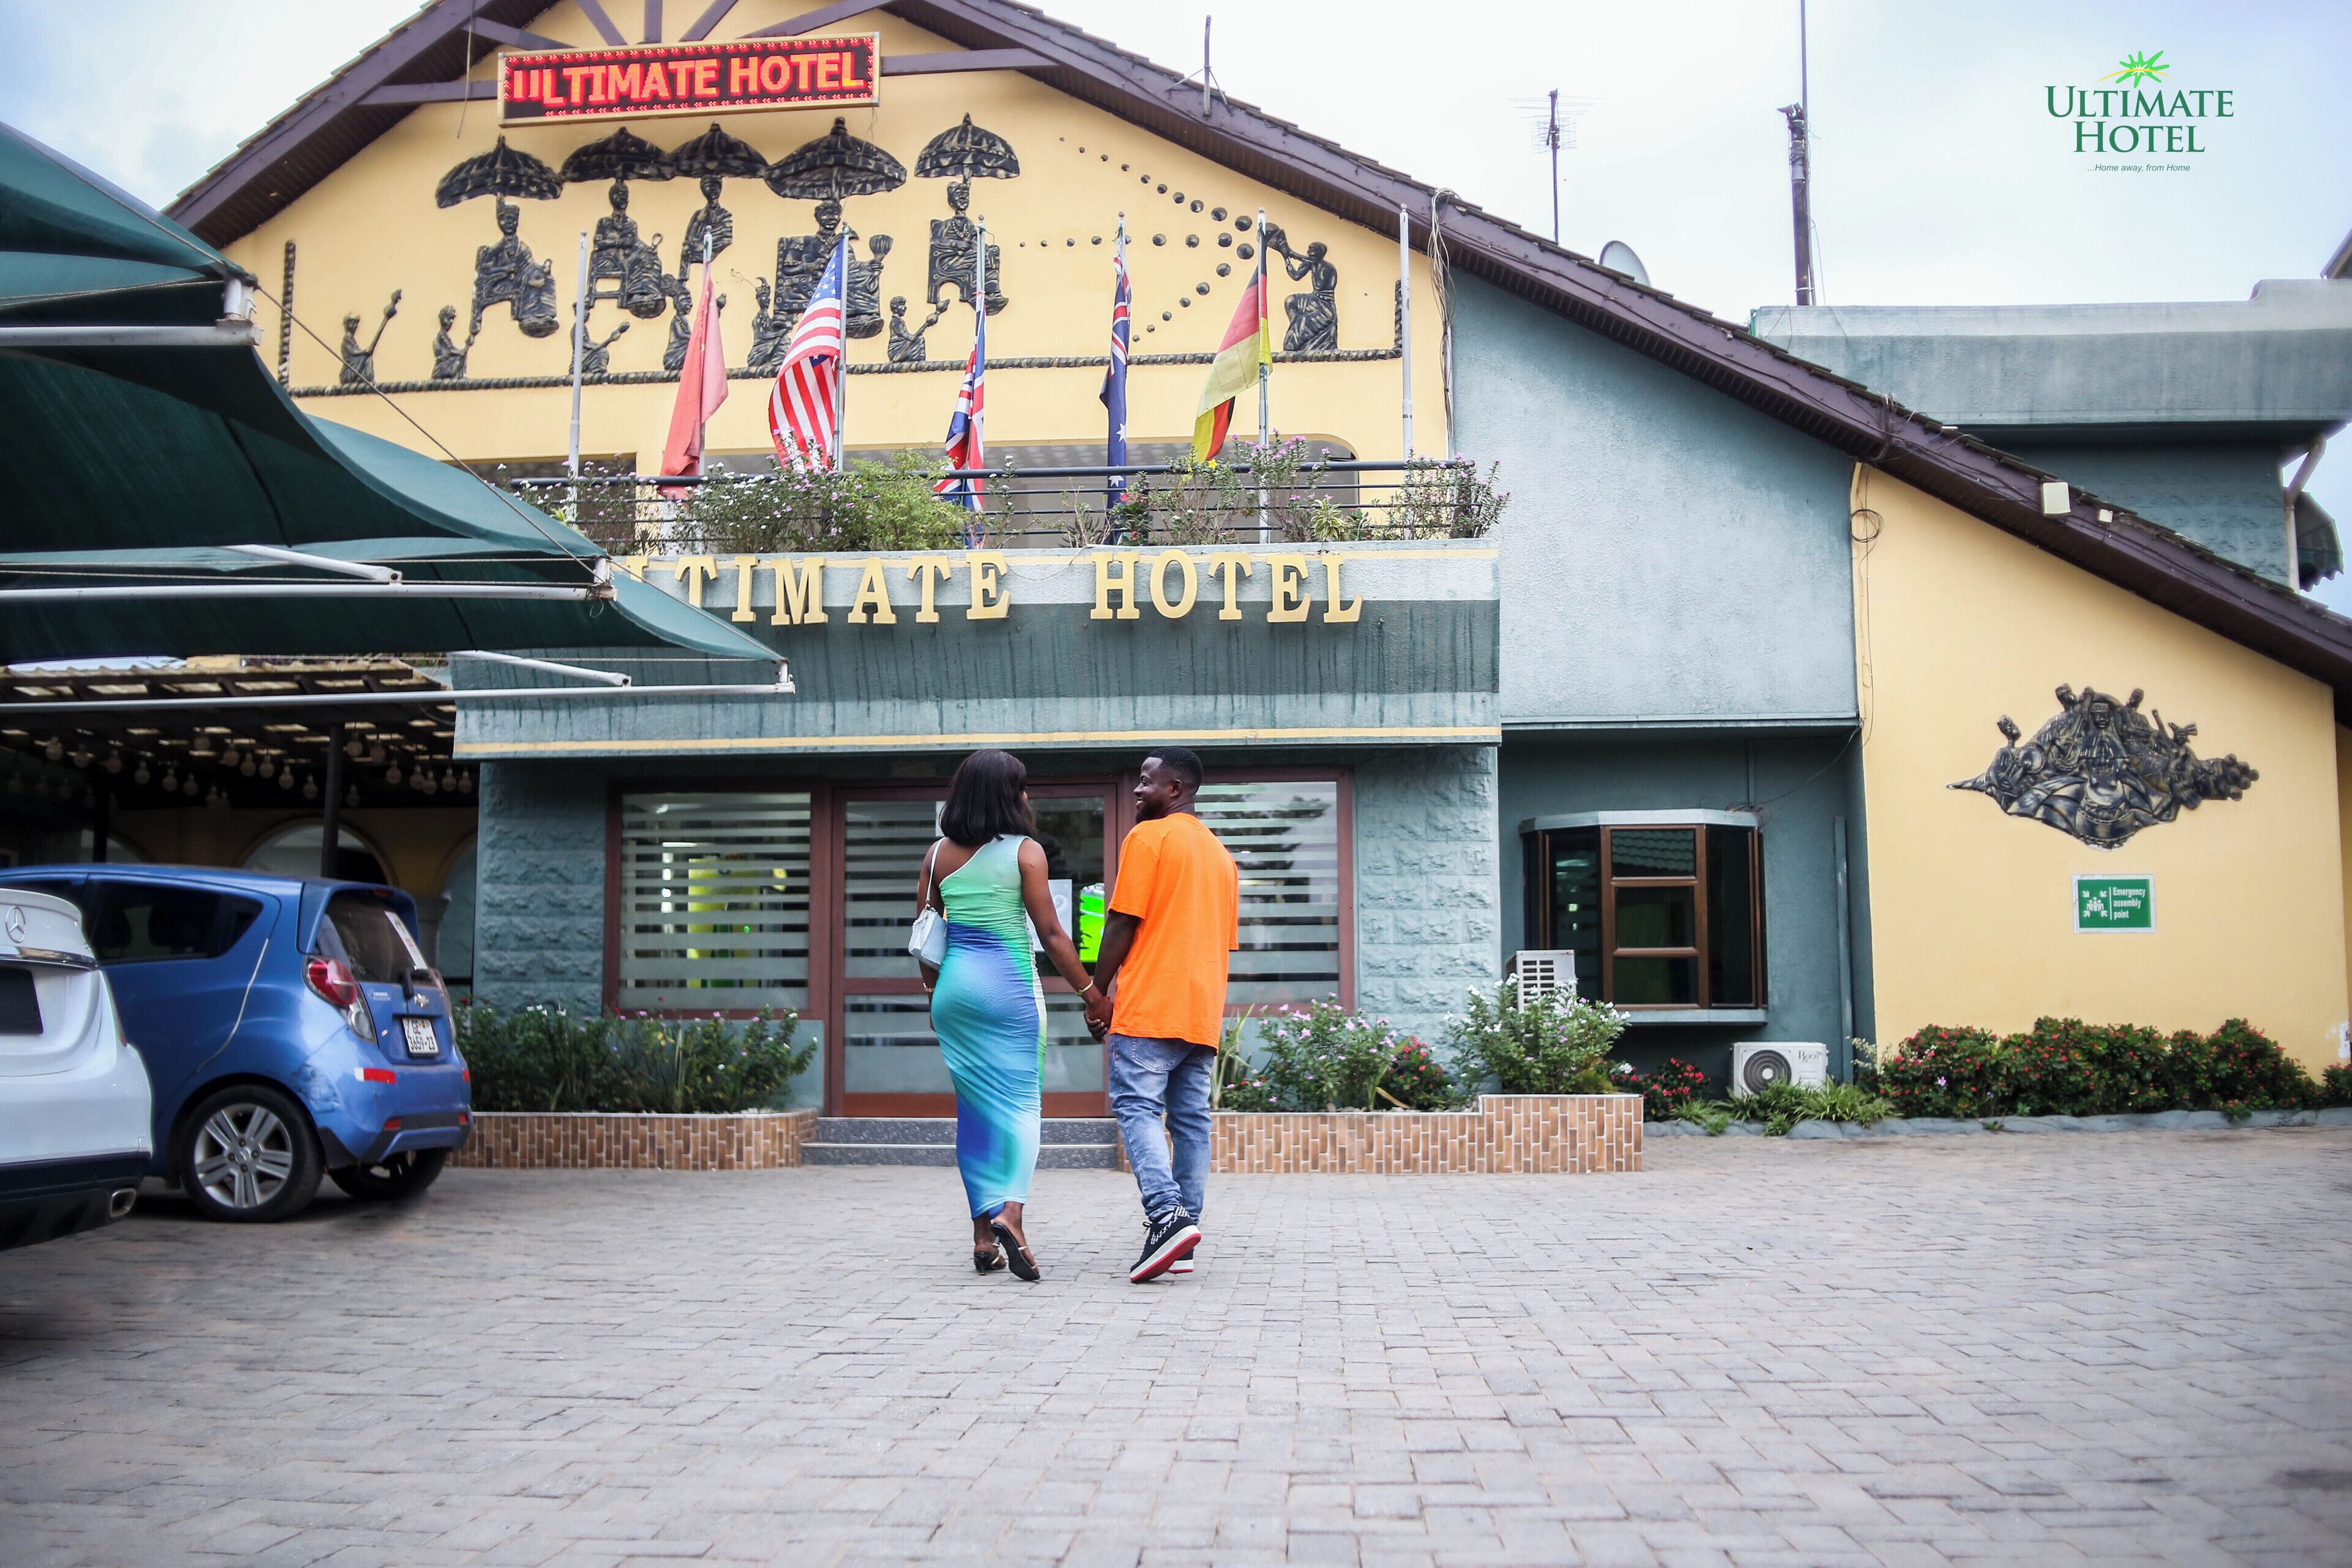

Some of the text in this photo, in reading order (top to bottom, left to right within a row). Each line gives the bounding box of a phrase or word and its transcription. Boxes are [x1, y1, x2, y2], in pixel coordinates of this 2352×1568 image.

[729, 51, 864, 94] HOTEL
[1090, 549, 1363, 624] HOTEL
[2113, 887, 2146, 897] Emergency
[2114, 898, 2141, 909] assembly
[2114, 910, 2129, 920] point
